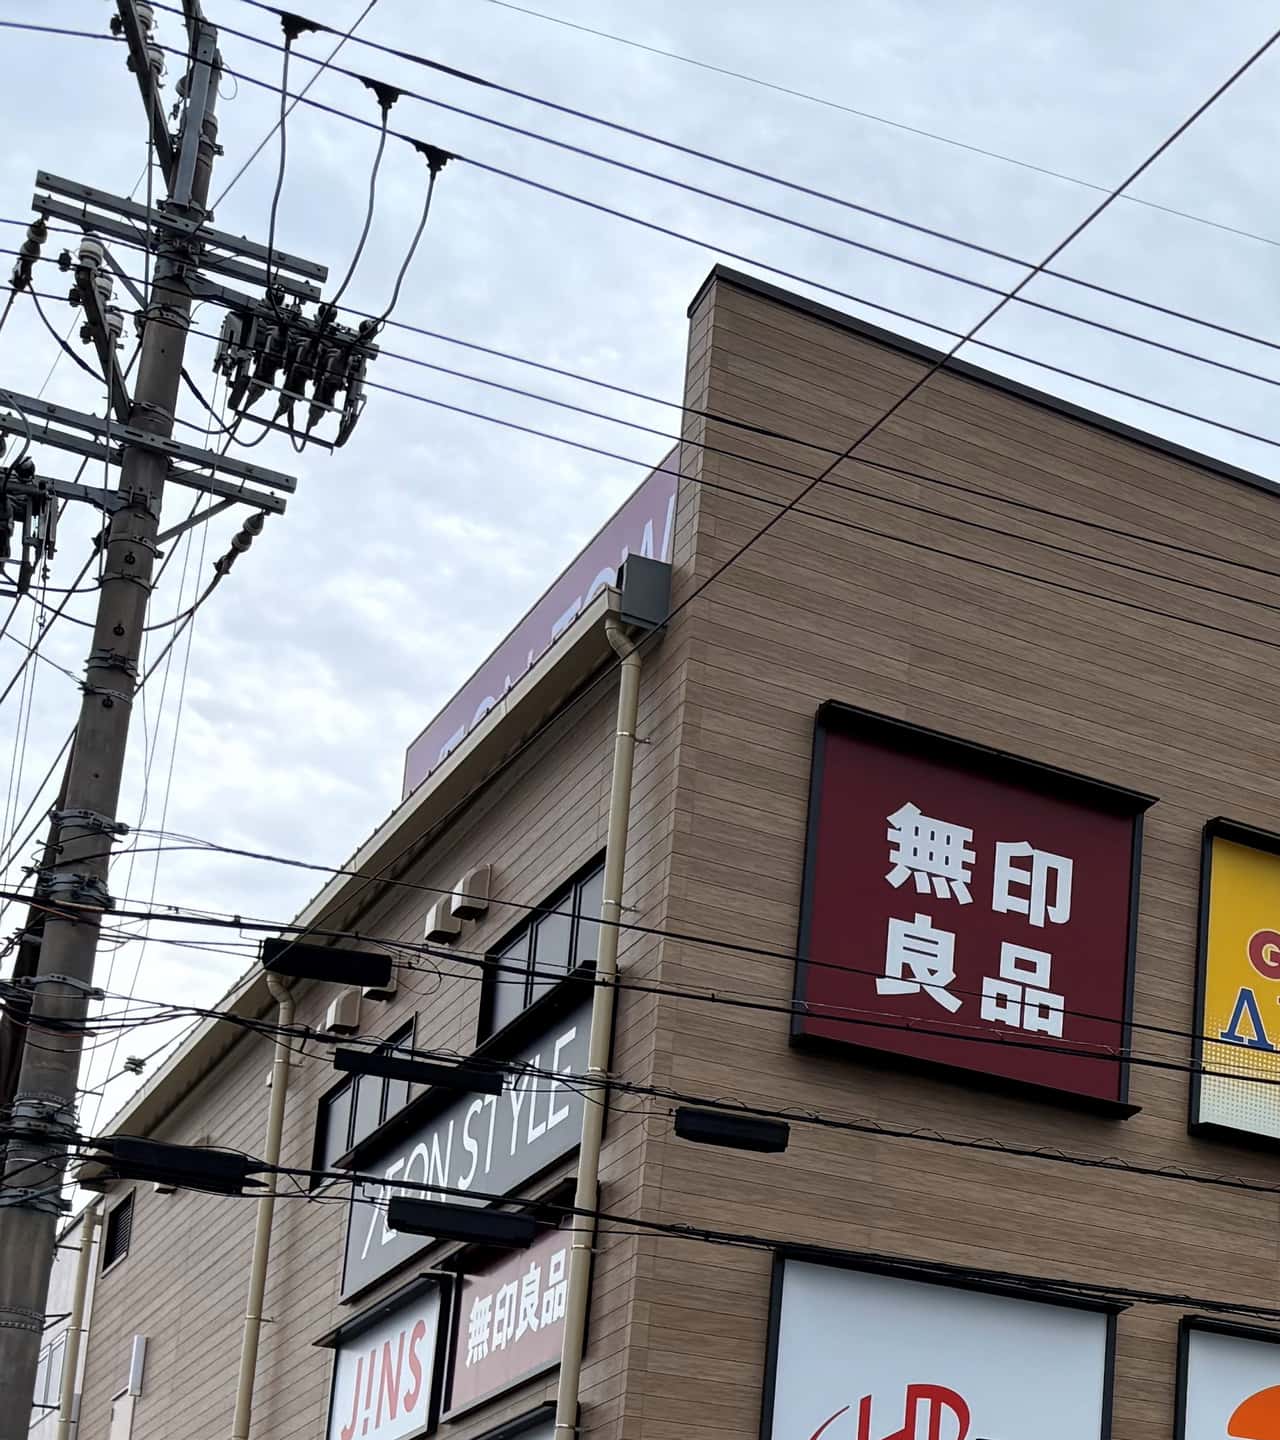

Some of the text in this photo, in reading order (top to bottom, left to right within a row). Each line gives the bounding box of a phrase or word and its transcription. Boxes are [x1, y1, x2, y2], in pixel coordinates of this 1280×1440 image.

[886, 802, 1073, 928] 無印
[875, 913, 1065, 1038] 良品
[458, 1026, 577, 1190] STYLE
[466, 1248, 568, 1368] 無印良品
